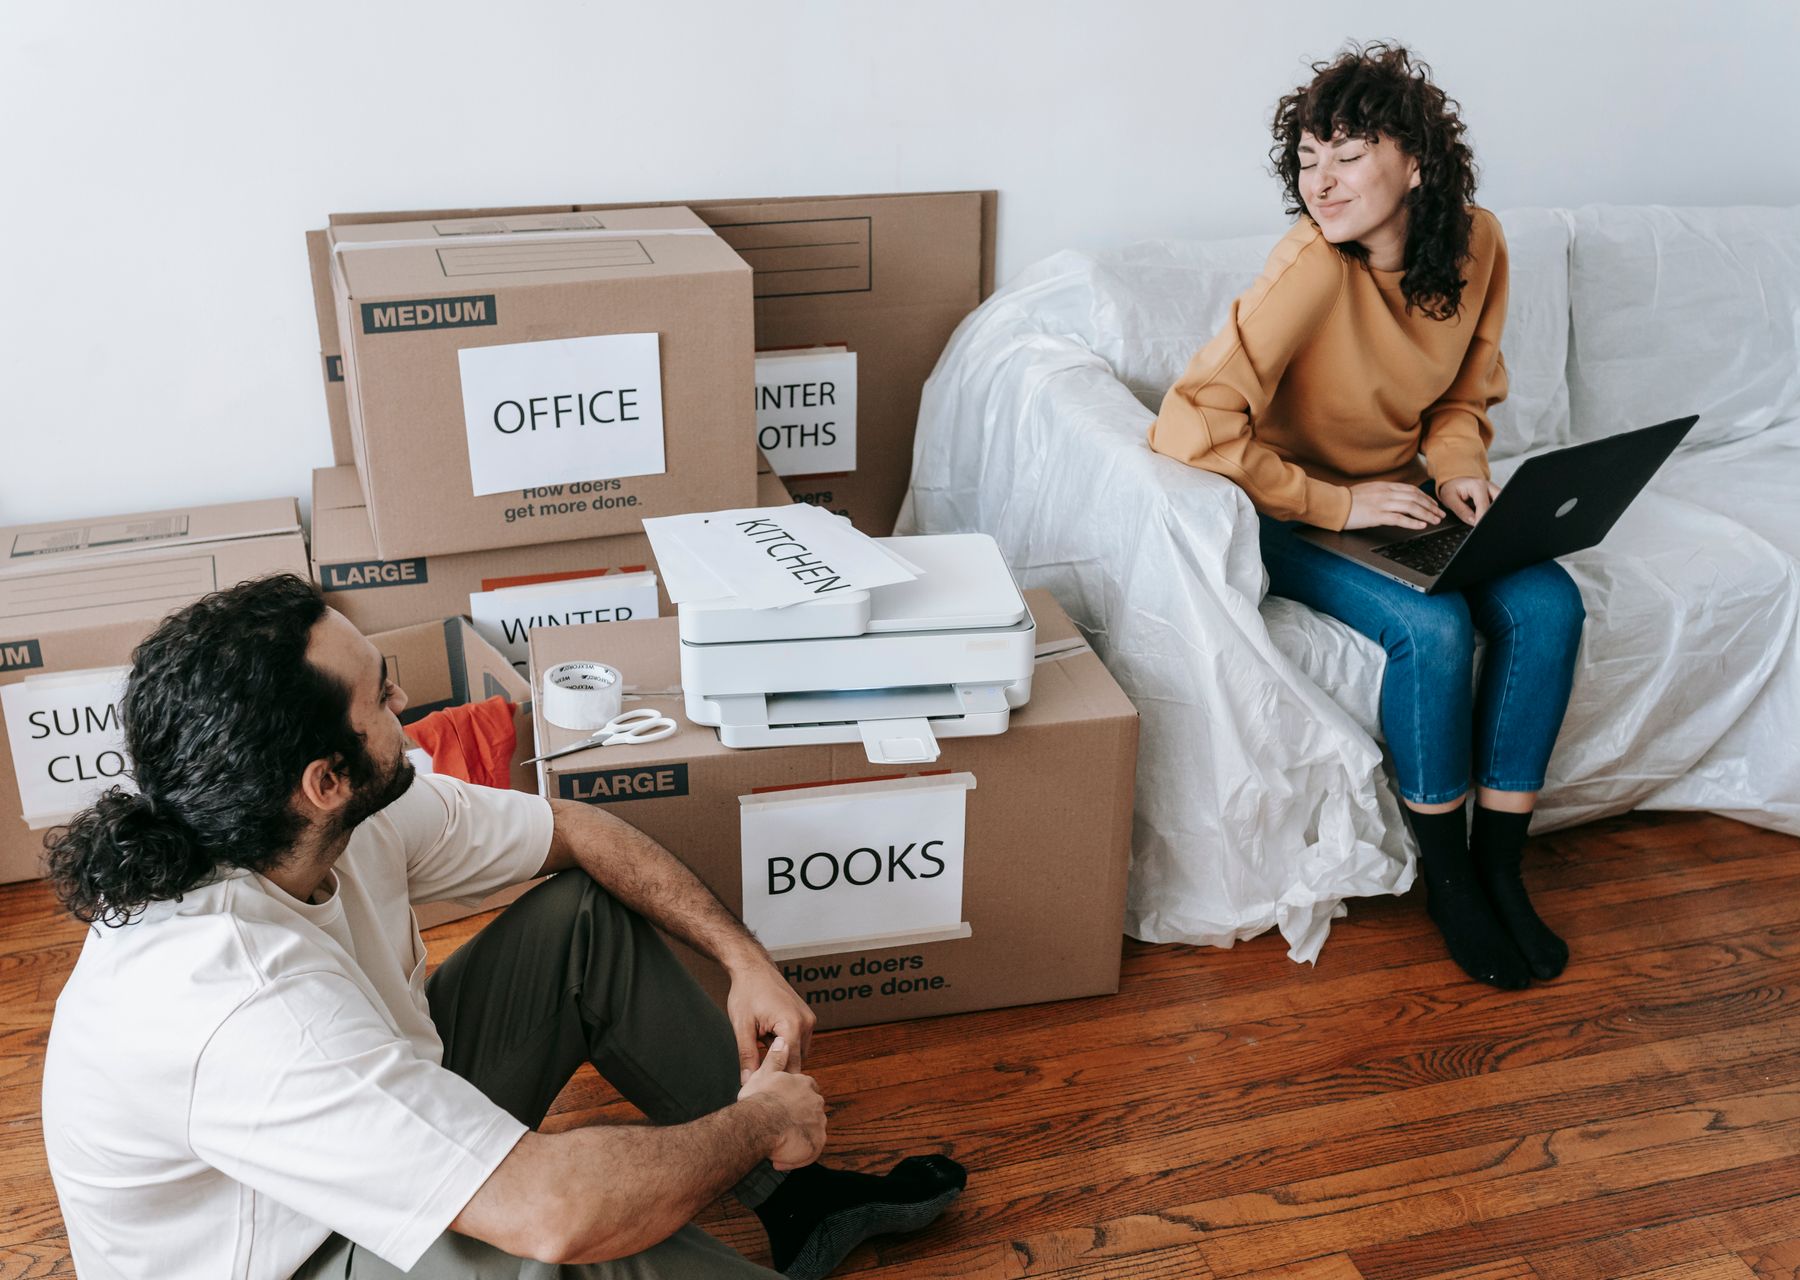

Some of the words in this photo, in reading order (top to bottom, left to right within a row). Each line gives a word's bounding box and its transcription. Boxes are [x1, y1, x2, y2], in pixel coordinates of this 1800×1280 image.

[373, 301, 486, 328] MEDIUM
[755, 381, 836, 410] INTER
[493, 388, 640, 434] OFFICE
[758, 421, 837, 450] OTHS
[522, 484, 564, 499] How
[569, 479, 621, 494] doers
[504, 503, 535, 523] get
[540, 501, 587, 516] more
[592, 495, 642, 510] done.
[736, 518, 851, 594] KITCHEN
[330, 562, 417, 587] LARGE
[28, 703, 119, 739] SUM
[48, 750, 126, 783] CLO
[572, 770, 676, 799] LARGE
[767, 840, 946, 895] BOOKS
[783, 964, 843, 983] How
[850, 955, 924, 976] doers
[806, 984, 873, 1005] more
[880, 975, 951, 996] done.
